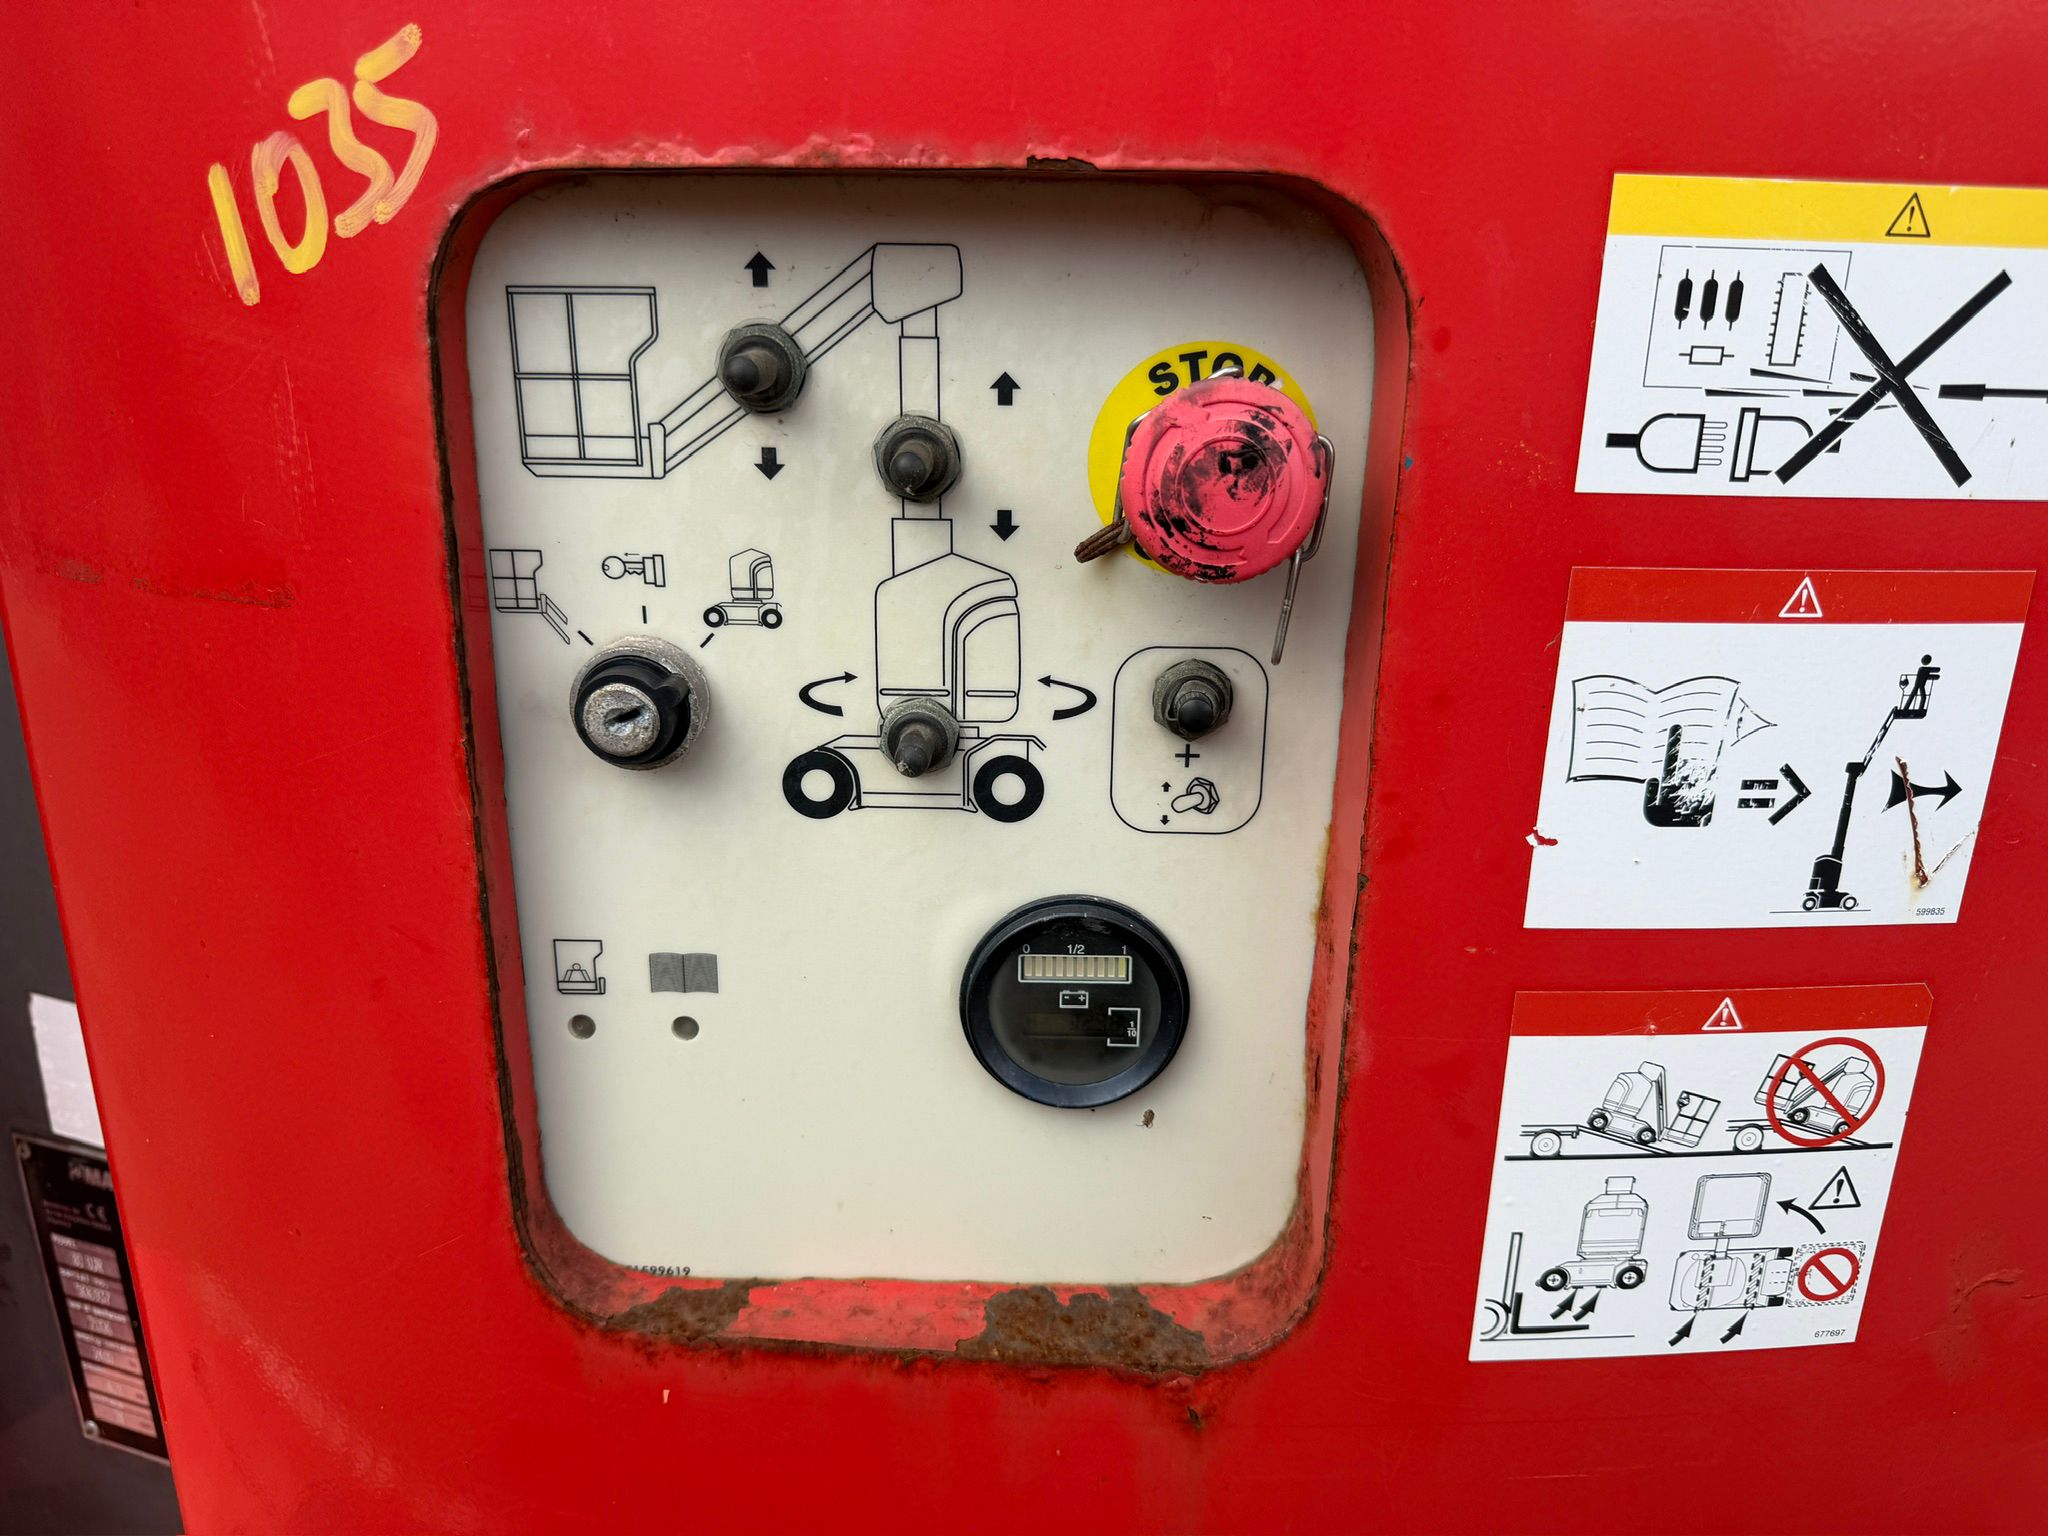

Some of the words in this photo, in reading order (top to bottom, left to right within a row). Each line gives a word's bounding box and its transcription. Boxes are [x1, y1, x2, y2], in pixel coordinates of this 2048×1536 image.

[207, 22, 439, 306] 1035
[1916, 907, 1946, 916] 599835
[1022, 944, 1031, 954] 0
[1067, 944, 1086, 955] 1/2
[1121, 944, 1127, 955] 1
[1814, 1329, 1846, 1337] 677697
